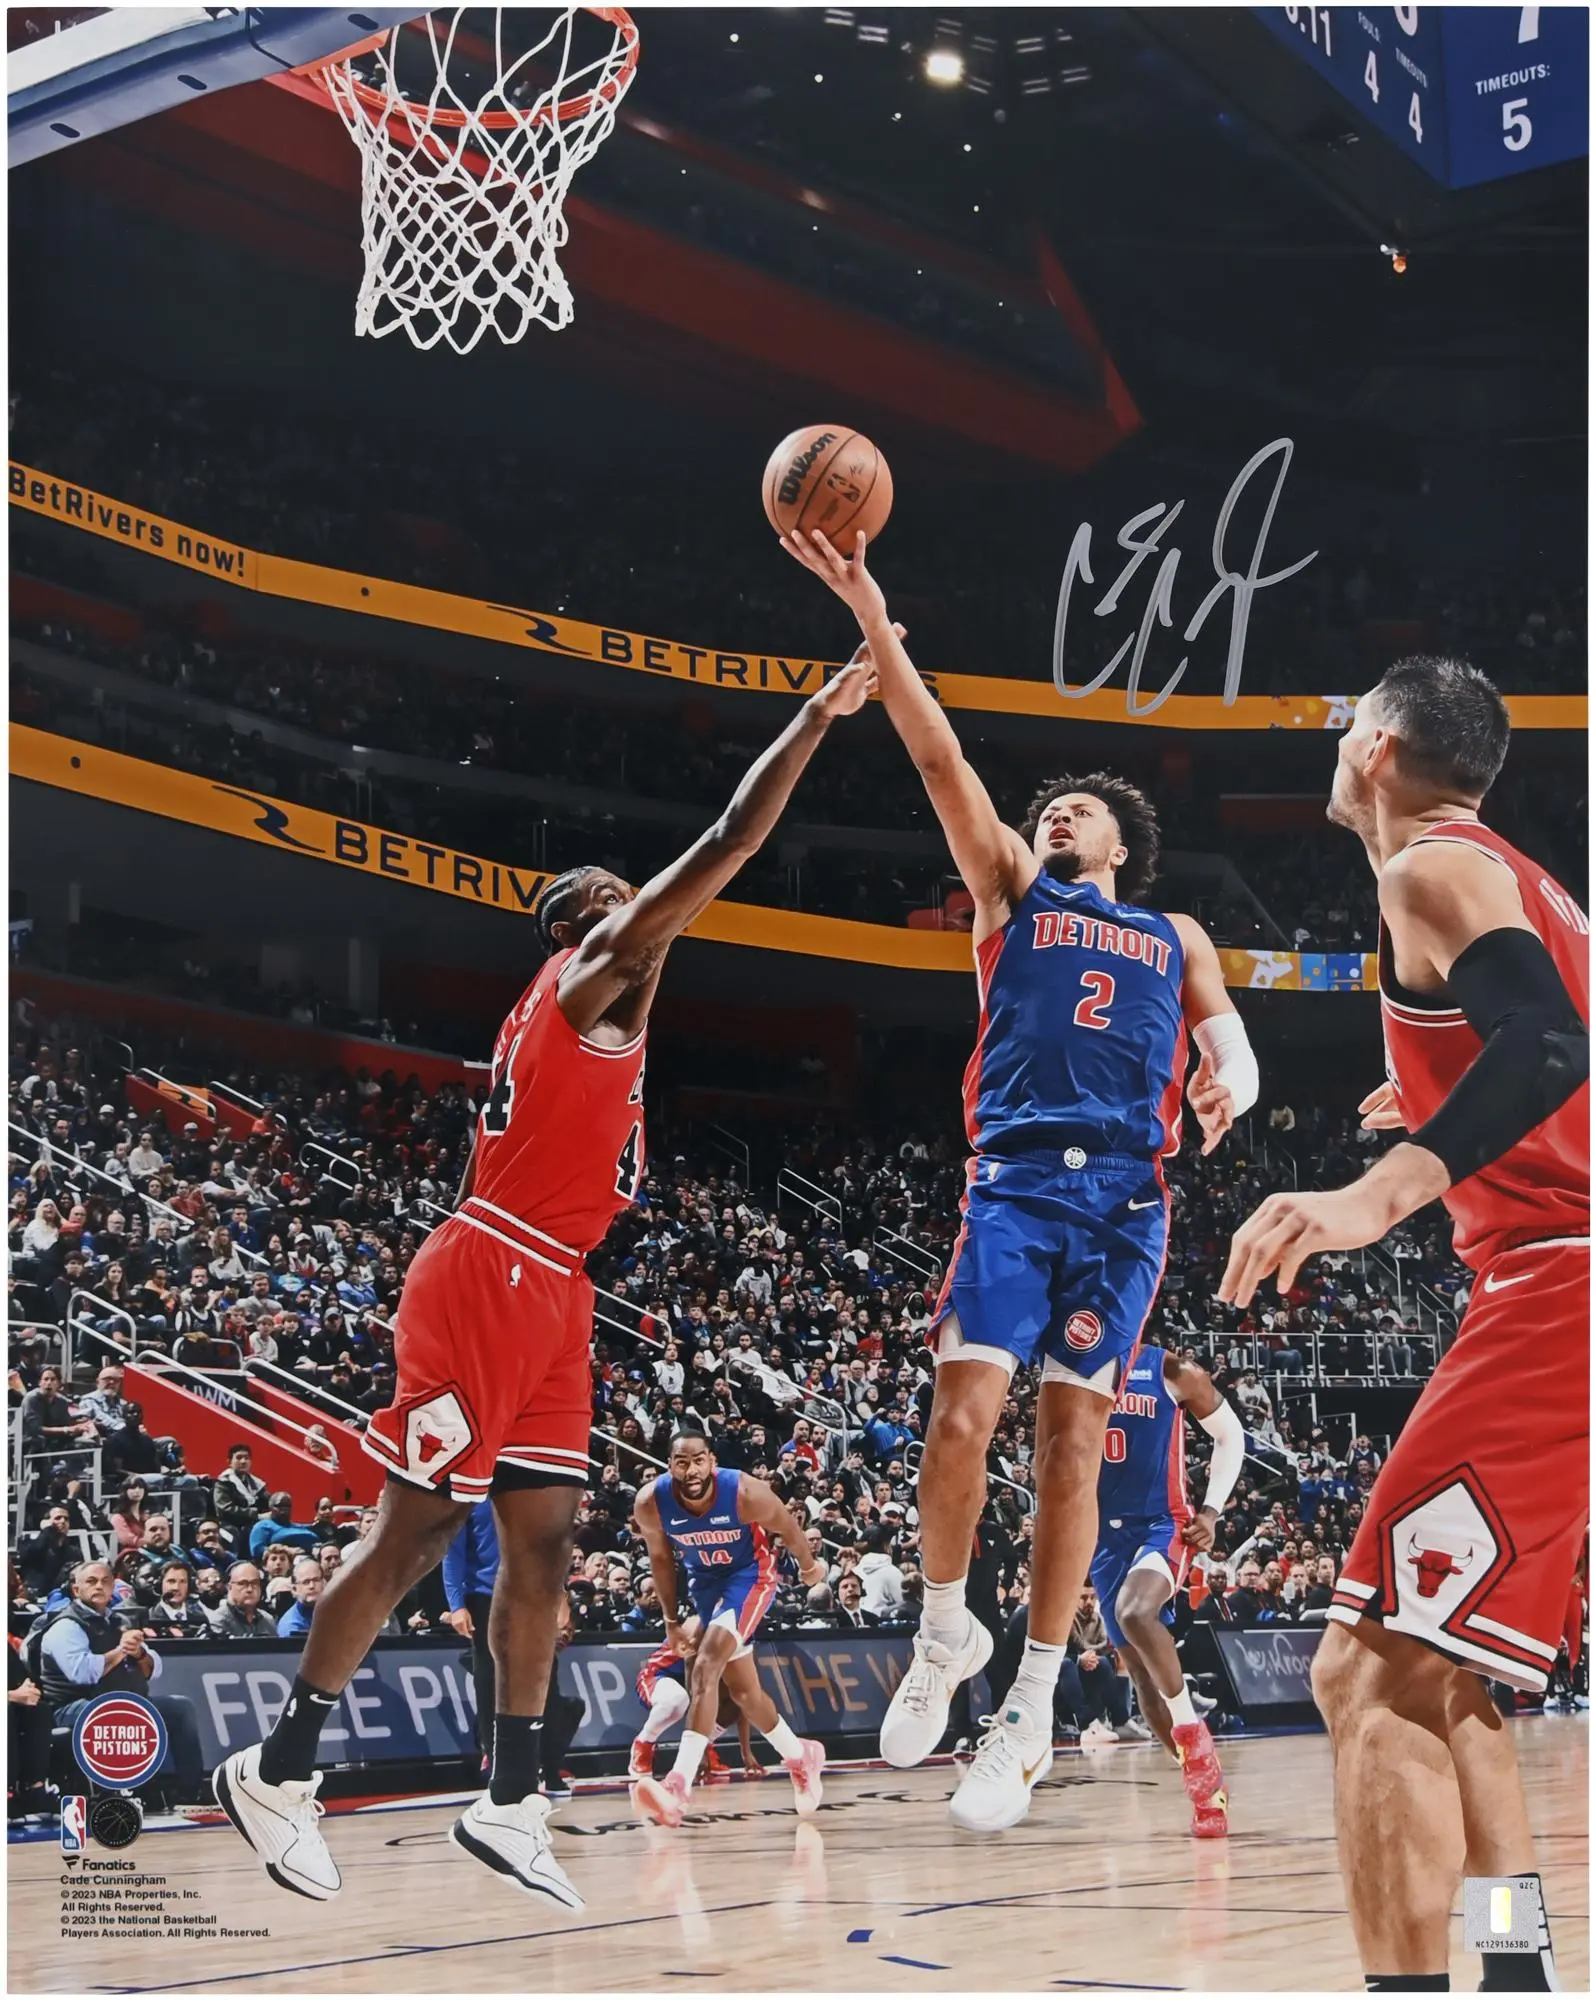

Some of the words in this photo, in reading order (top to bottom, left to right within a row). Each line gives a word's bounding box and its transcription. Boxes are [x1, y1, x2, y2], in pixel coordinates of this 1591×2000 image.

[1364, 50, 1380, 103] 4
[1475, 64, 1551, 95] TIMEOUTS:
[1408, 92, 1423, 143] 4
[1502, 98, 1532, 151] 5
[8, 465, 164, 548] BetRivers
[177, 533, 244, 577] now!
[335, 820, 546, 909] BETRIV
[1032, 912, 1173, 976] DETROIT
[1073, 970, 1116, 1030] 2
[614, 1119, 641, 1200] 4
[1103, 1427, 1127, 1464] 0
[698, 1549, 734, 1567] 14
[202, 1662, 392, 1748] FRE
[757, 1654, 869, 1715] THE
